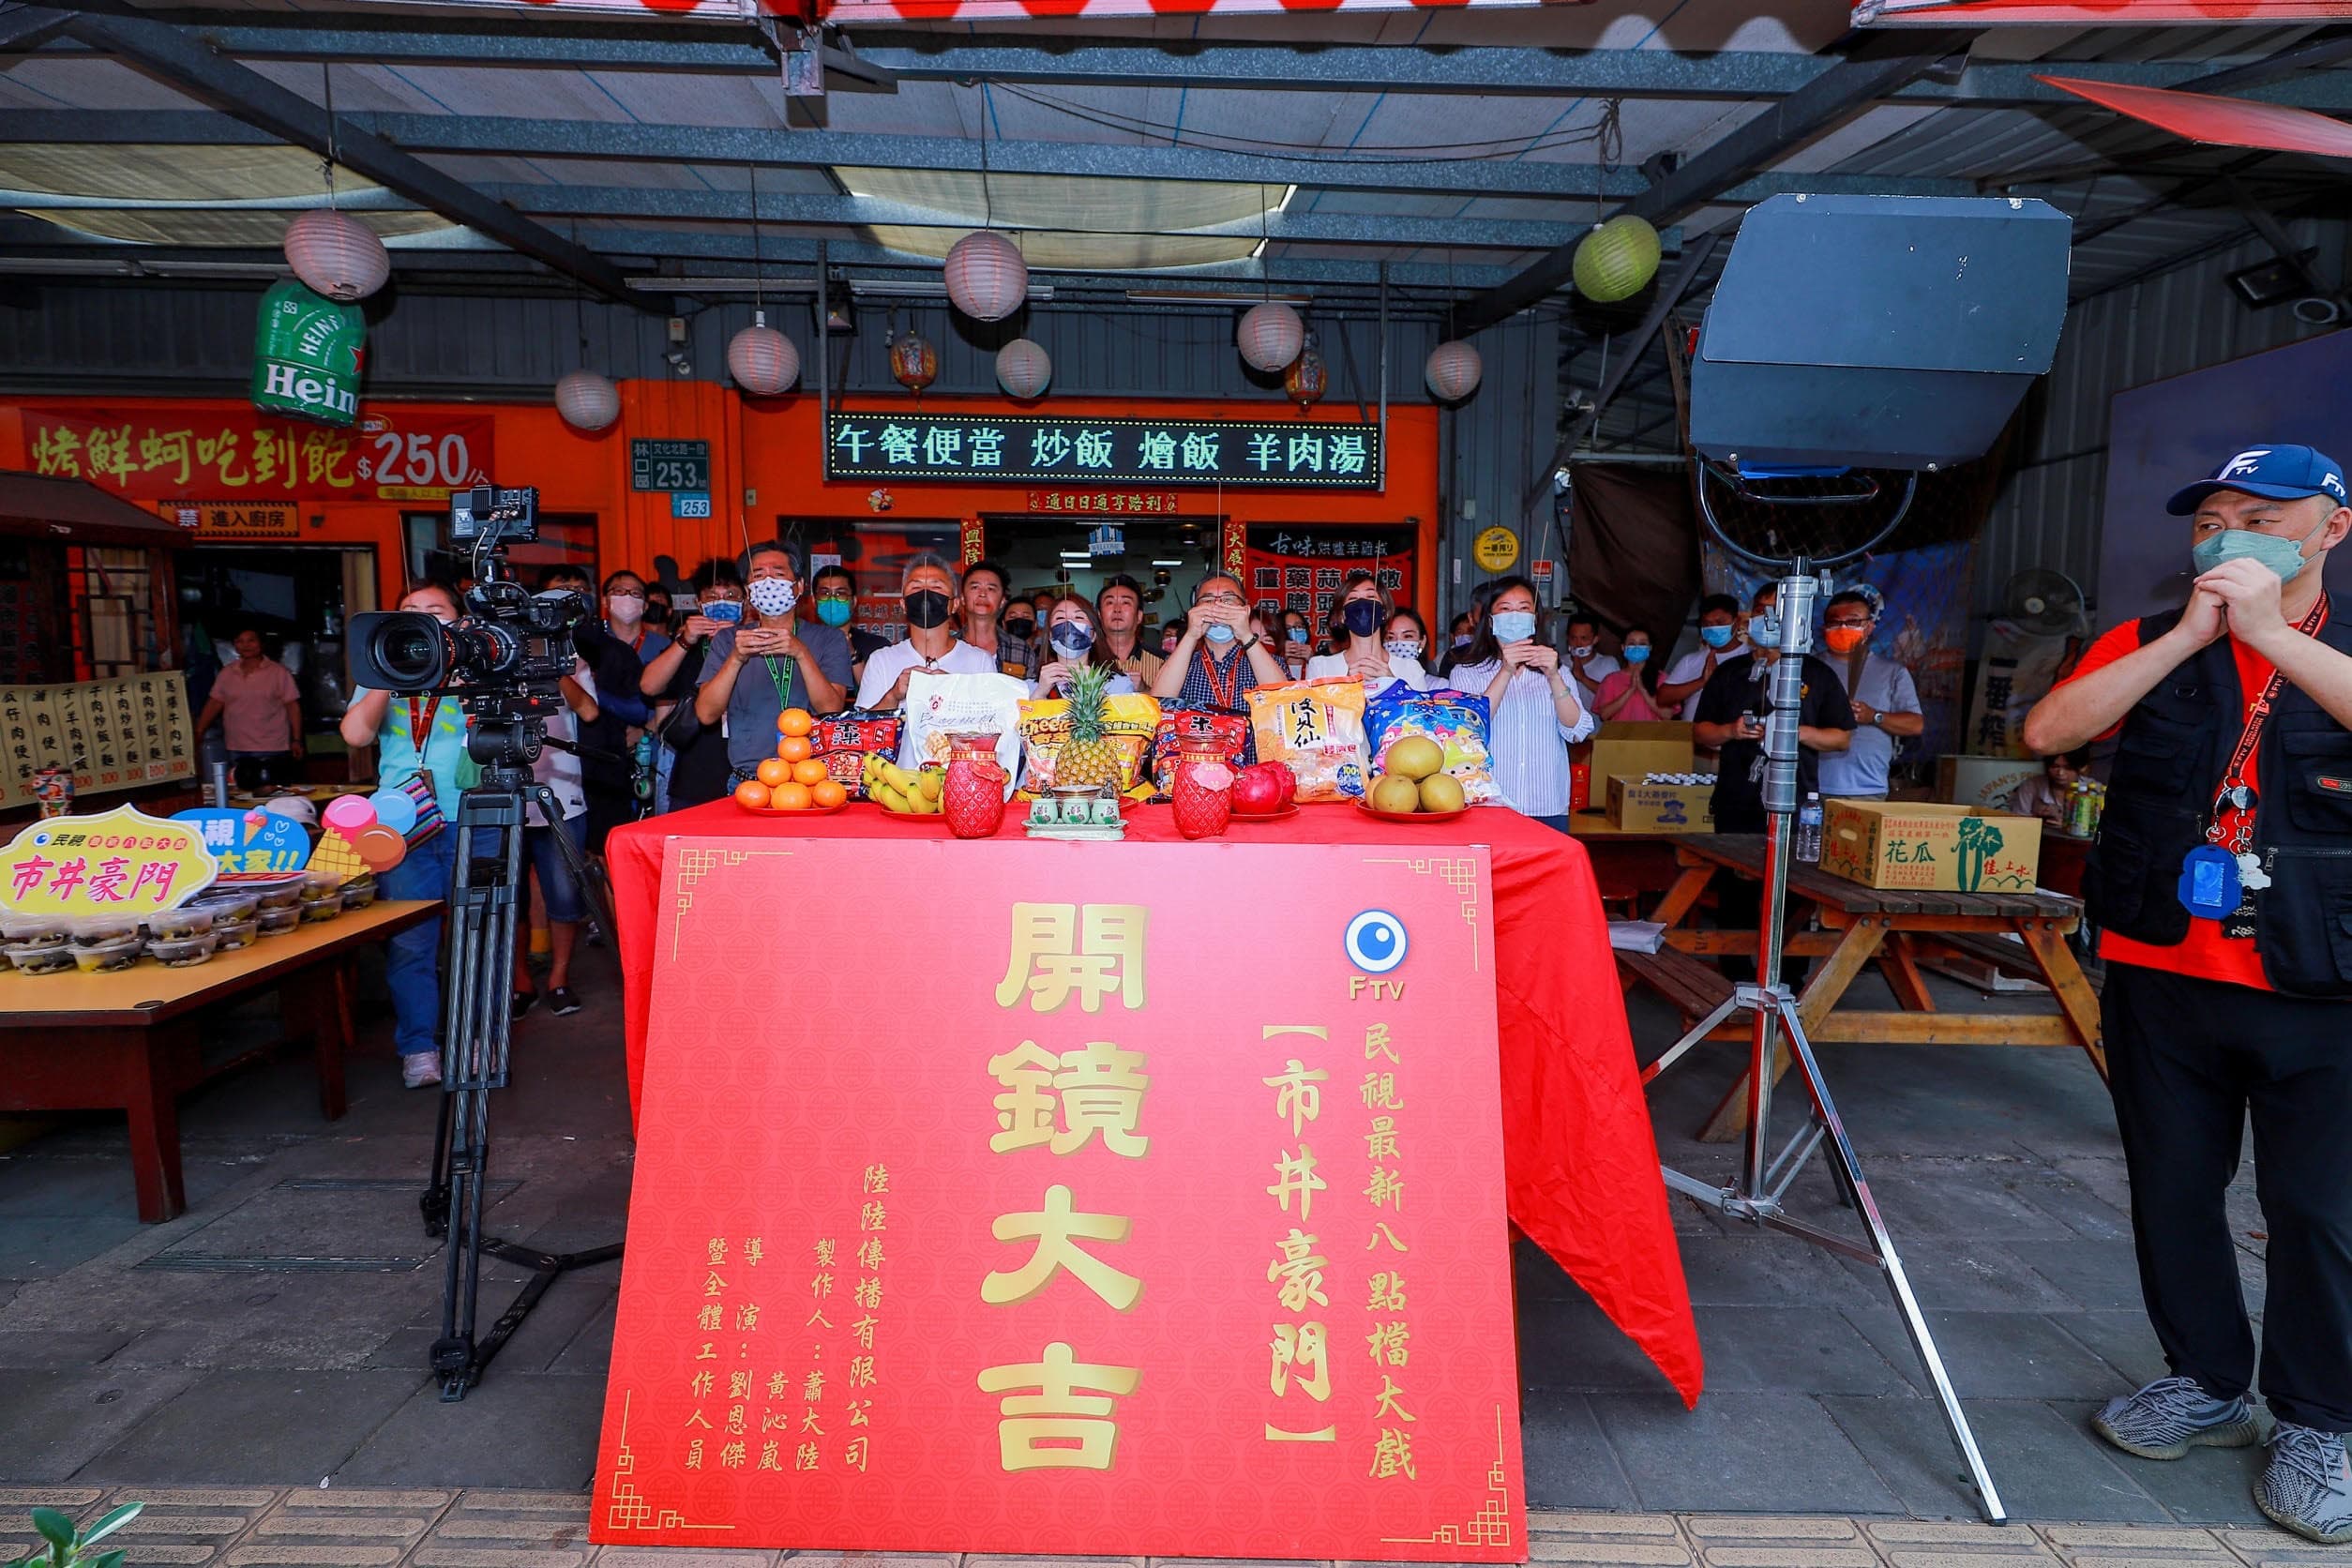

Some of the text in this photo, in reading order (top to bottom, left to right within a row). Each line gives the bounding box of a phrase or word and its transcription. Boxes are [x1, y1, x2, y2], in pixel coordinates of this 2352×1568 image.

[33, 424, 354, 490] 烤鮮蚵吃到飽
[633, 443, 649, 488] 林口區
[836, 424, 1366, 474] 午餐便當 炒飯 燴飯 羊肉湯
[2216, 450, 2272, 480] FTV
[656, 461, 697, 488] 253
[211, 510, 285, 527] 進入廚房
[683, 501, 708, 515] 253
[1884, 839, 1936, 864] 花瓜
[12, 854, 179, 902] 市井豪門
[1349, 975, 1405, 1001] FTV
[976, 901, 1152, 1474] 開鏡大吉
[1359, 1021, 1418, 1481] 民視最新八點檔大戲
[845, 1162, 891, 1473] 陸陸傳播有限公司
[684, 1237, 730, 1470] 暨全體工作人員
[757, 1370, 790, 1471] 黃沁嵐
